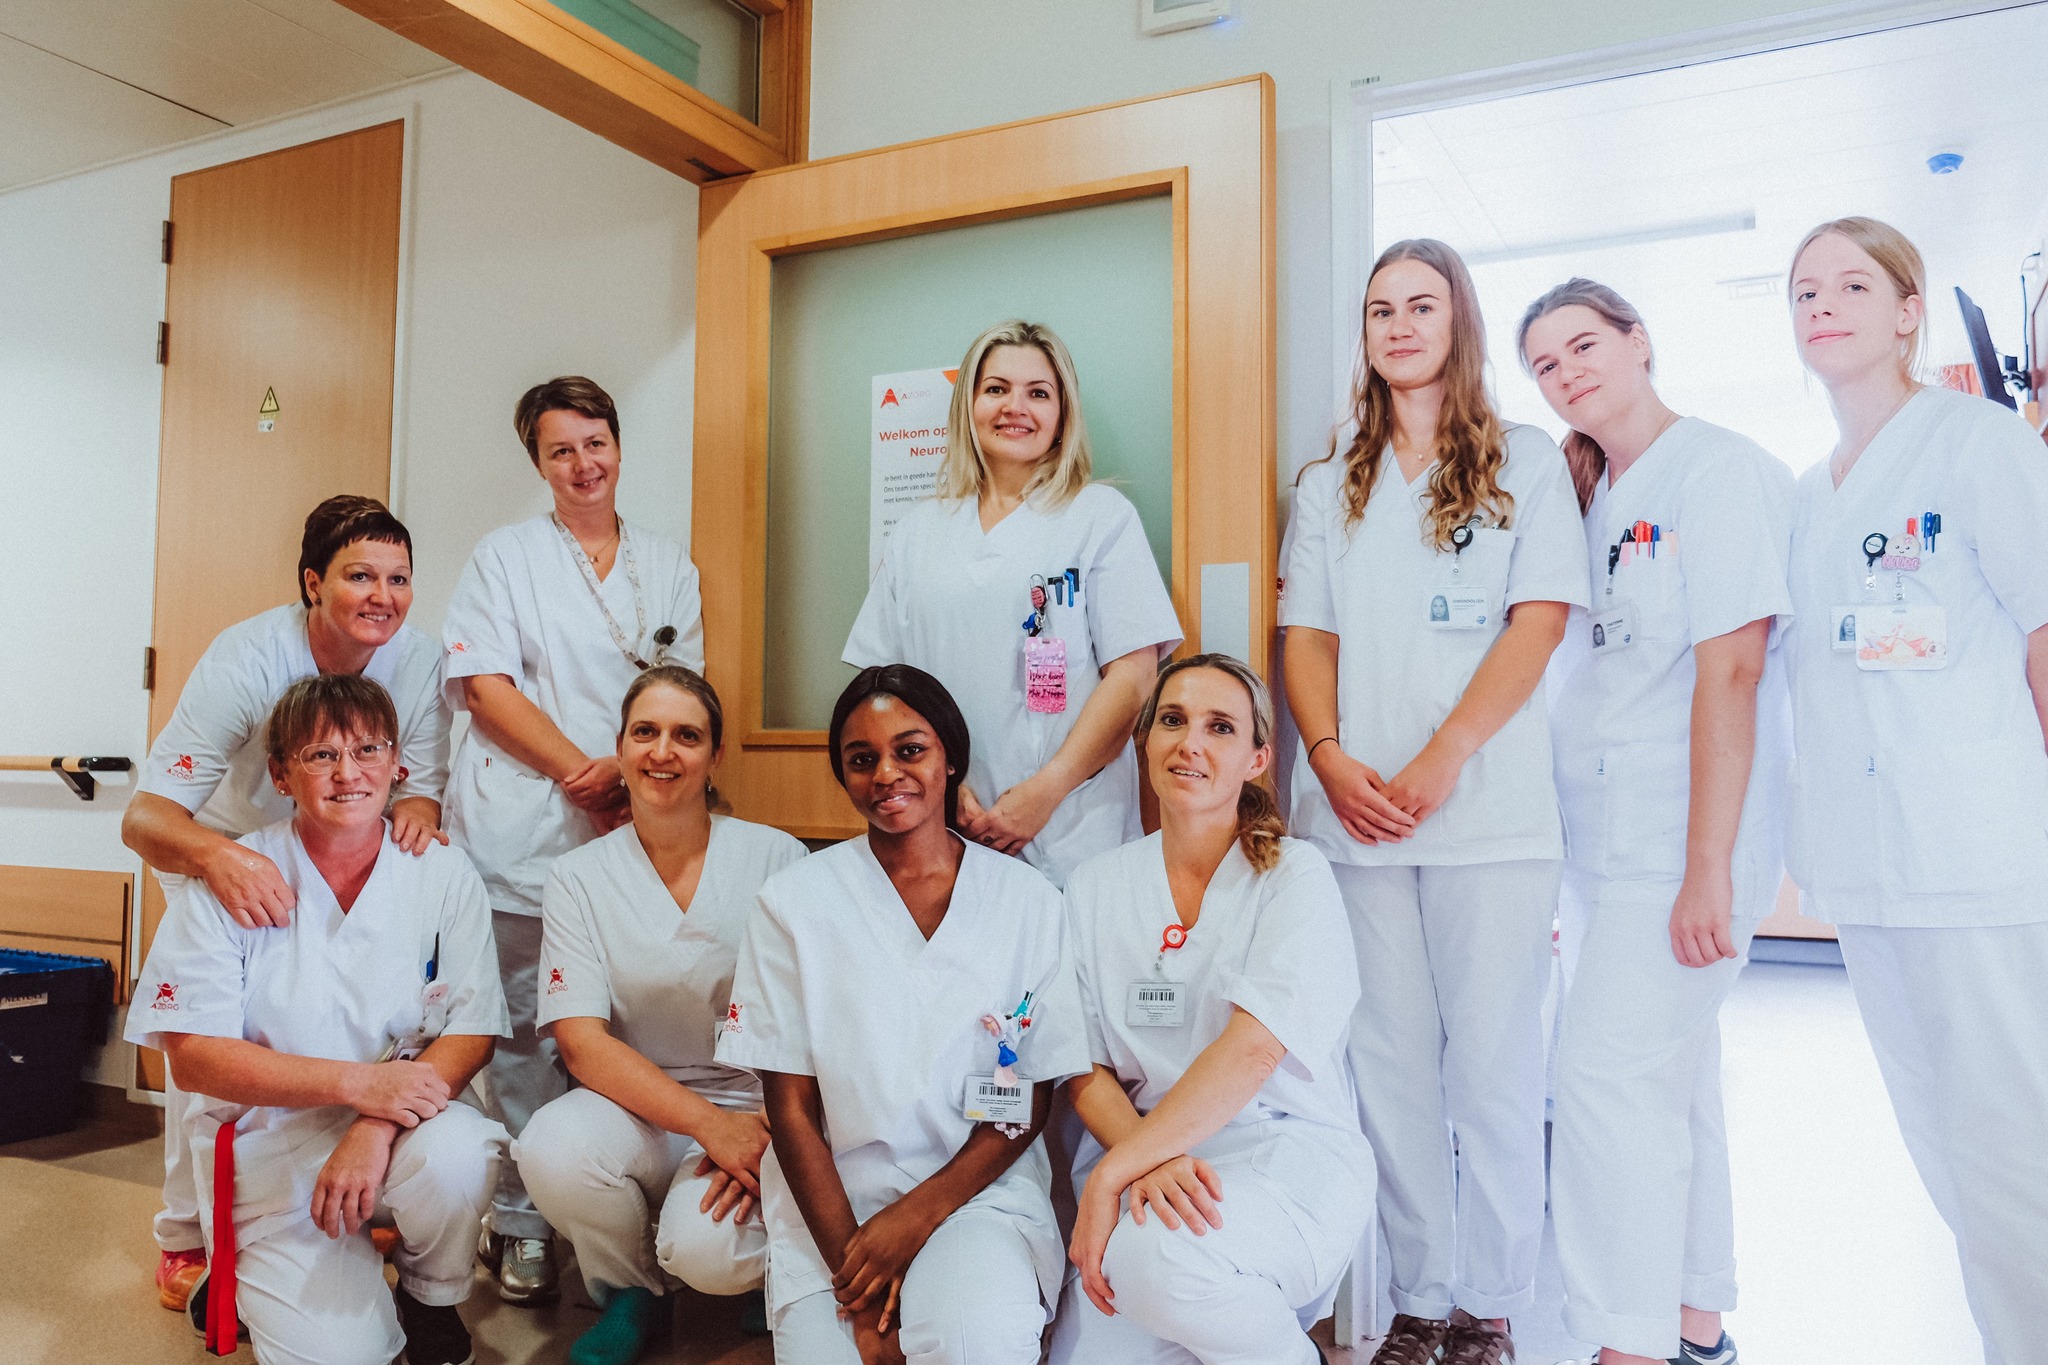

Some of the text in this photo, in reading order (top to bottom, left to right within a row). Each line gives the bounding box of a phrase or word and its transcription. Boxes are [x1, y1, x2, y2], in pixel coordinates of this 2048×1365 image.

[879, 427, 948, 442] Welkom op
[910, 446, 947, 457] Neuro
[909, 472, 926, 480] goede
[166, 768, 195, 782] AZORG
[547, 984, 569, 995] AZORG
[149, 1003, 180, 1011] AZORG
